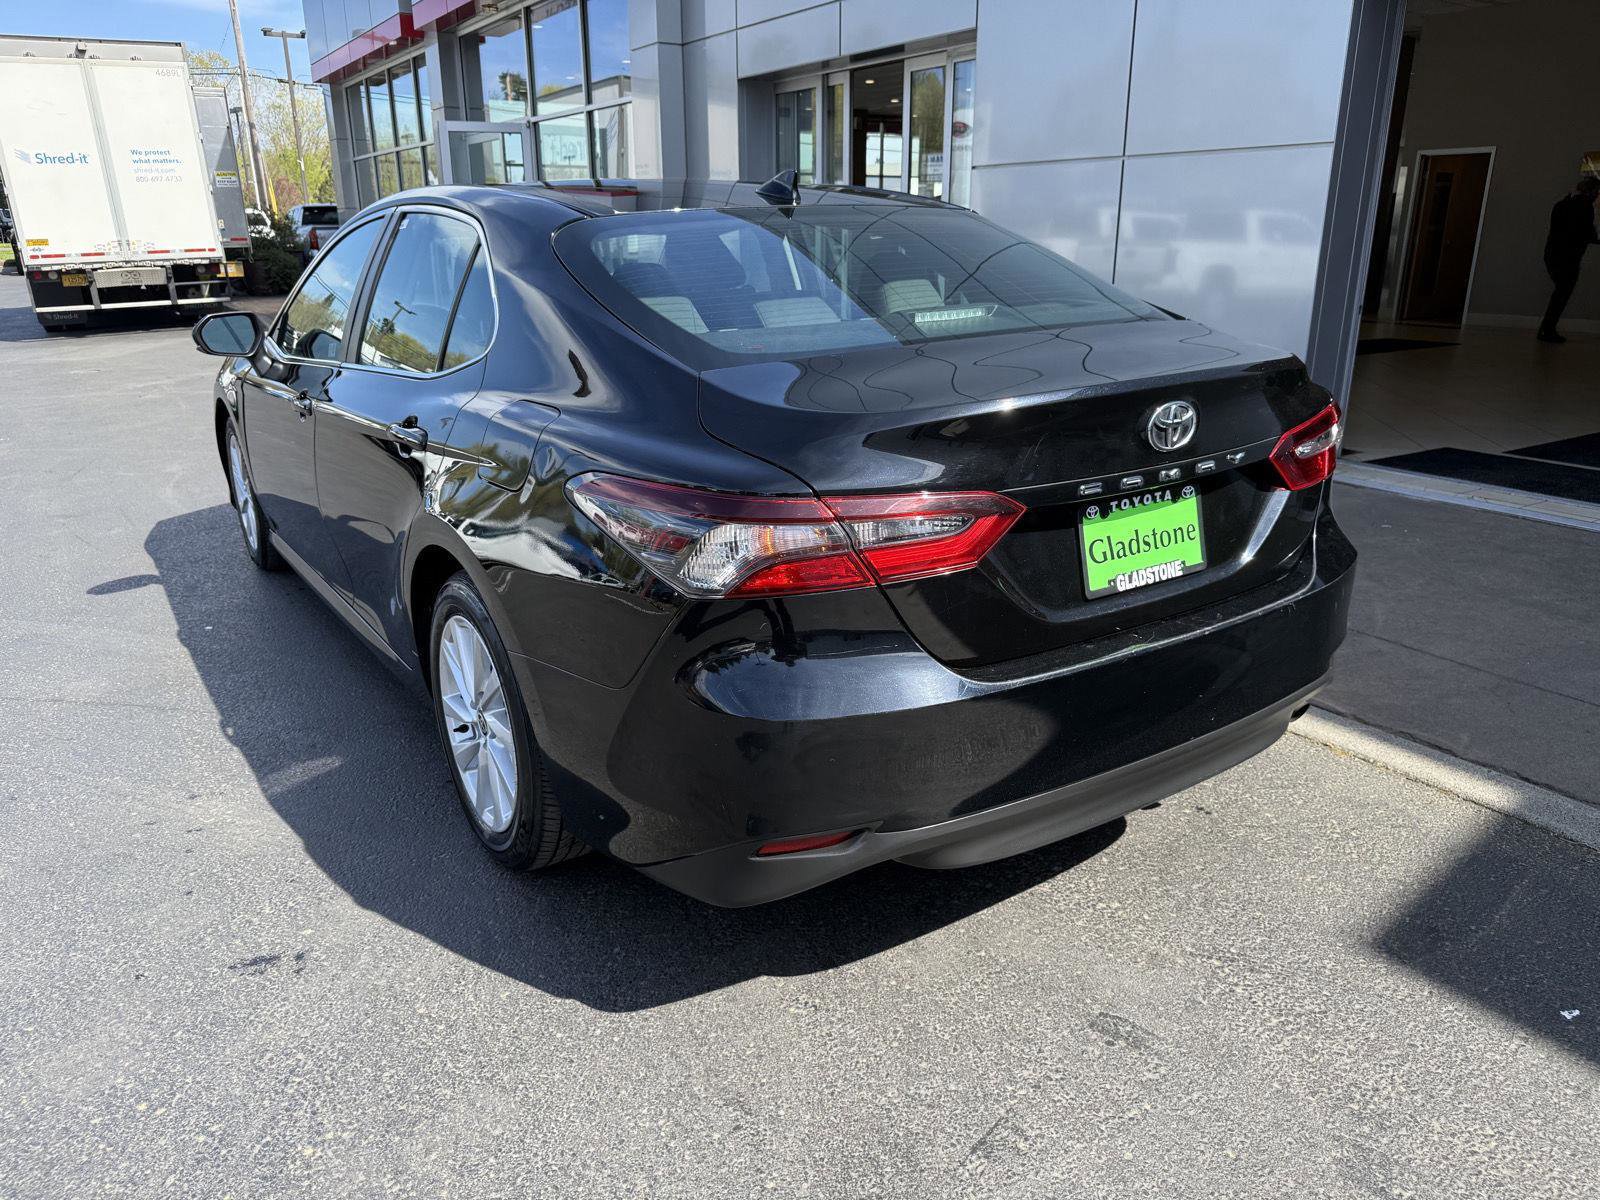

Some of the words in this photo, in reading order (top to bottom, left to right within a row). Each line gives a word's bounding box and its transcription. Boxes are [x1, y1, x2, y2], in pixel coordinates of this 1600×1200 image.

[35, 152, 89, 164] Shred-it
[144, 149, 171, 157] protect
[52, 312, 79, 321] Shred-it
[1079, 452, 1246, 496] CAMRY
[1110, 490, 1172, 511] TOYOTA
[1088, 523, 1197, 564] Gladstone
[1116, 561, 1184, 592] GLADSTONE
